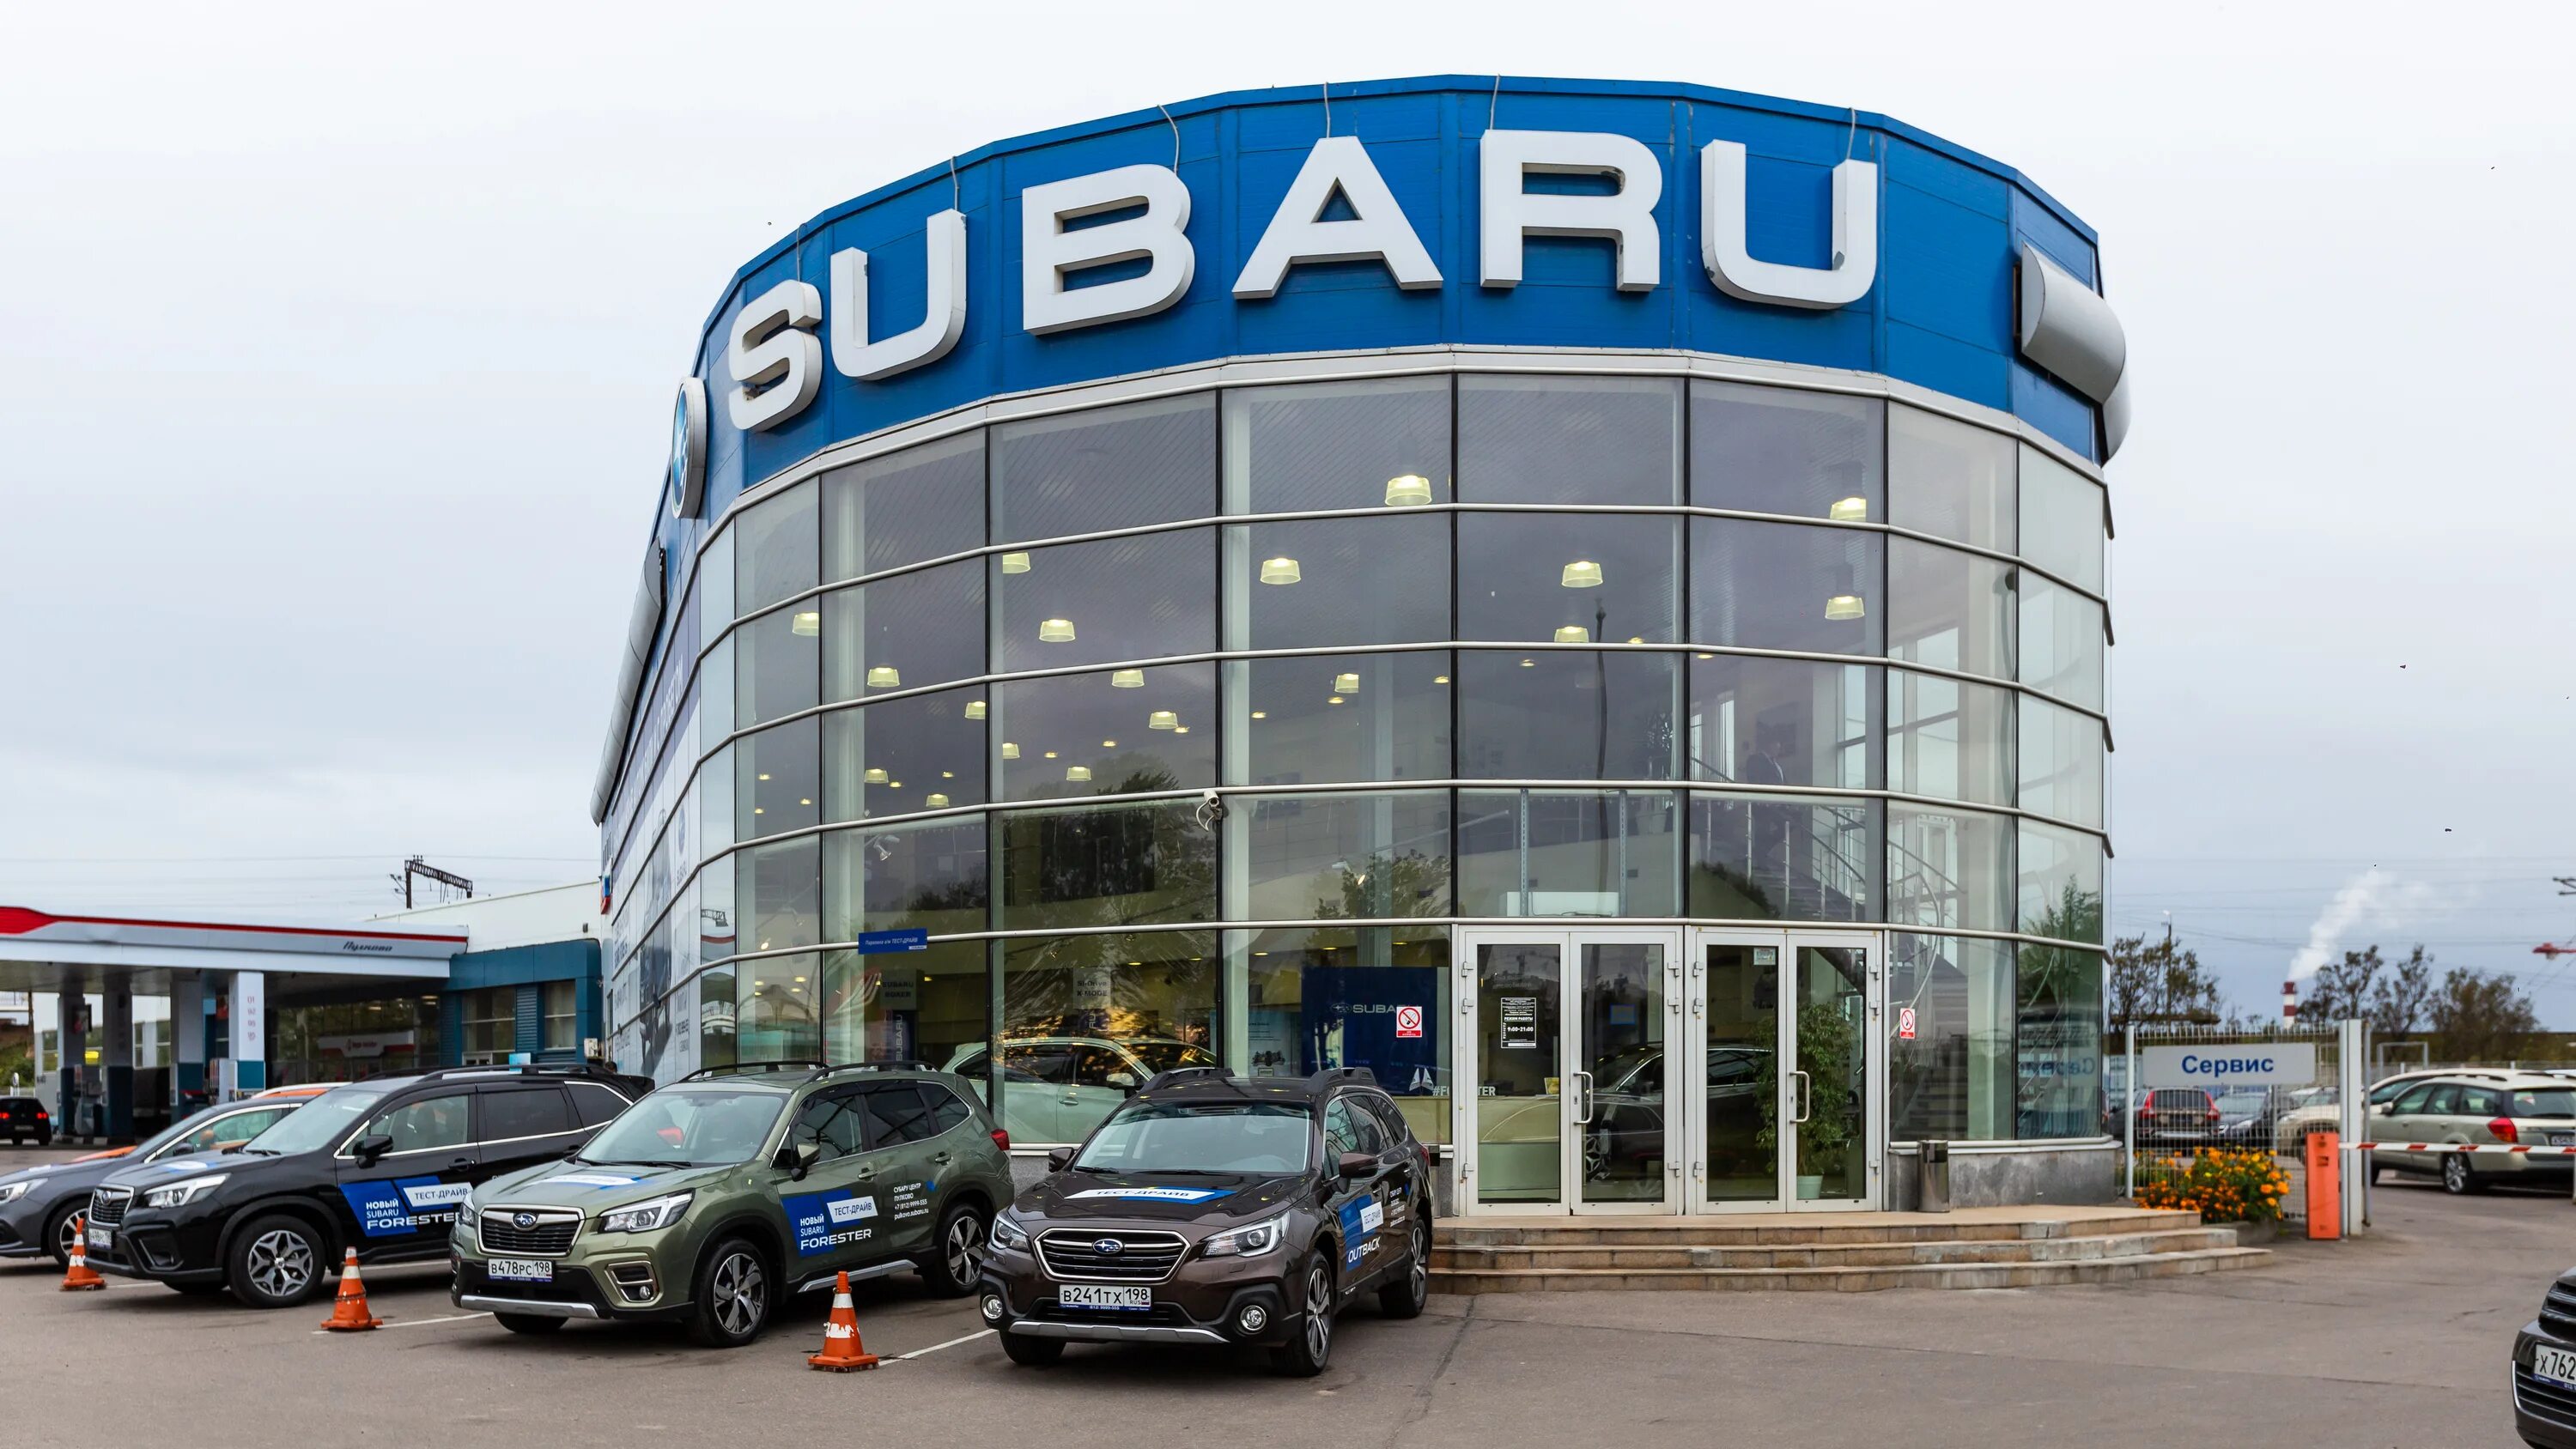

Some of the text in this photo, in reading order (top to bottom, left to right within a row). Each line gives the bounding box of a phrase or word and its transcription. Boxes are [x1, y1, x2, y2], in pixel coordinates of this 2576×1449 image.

[728, 128, 1879, 432] SUBARU
[2182, 1055, 2274, 1078] Сервис
[415, 1187, 468, 1201] ТЕСТ-ДРАЙВ
[366, 1197, 398, 1210] НОВЫЙ
[834, 1202, 872, 1216] ТЕСТ-ДРАЙВ
[367, 1208, 399, 1219] SUBARU
[800, 1213, 824, 1227] НОВЫЙ
[800, 1225, 824, 1237] SUBARU
[800, 1228, 872, 1251] FORESTER
[1348, 1236, 1381, 1263] OUTBACK
[1125, 1288, 1148, 1300] 198
